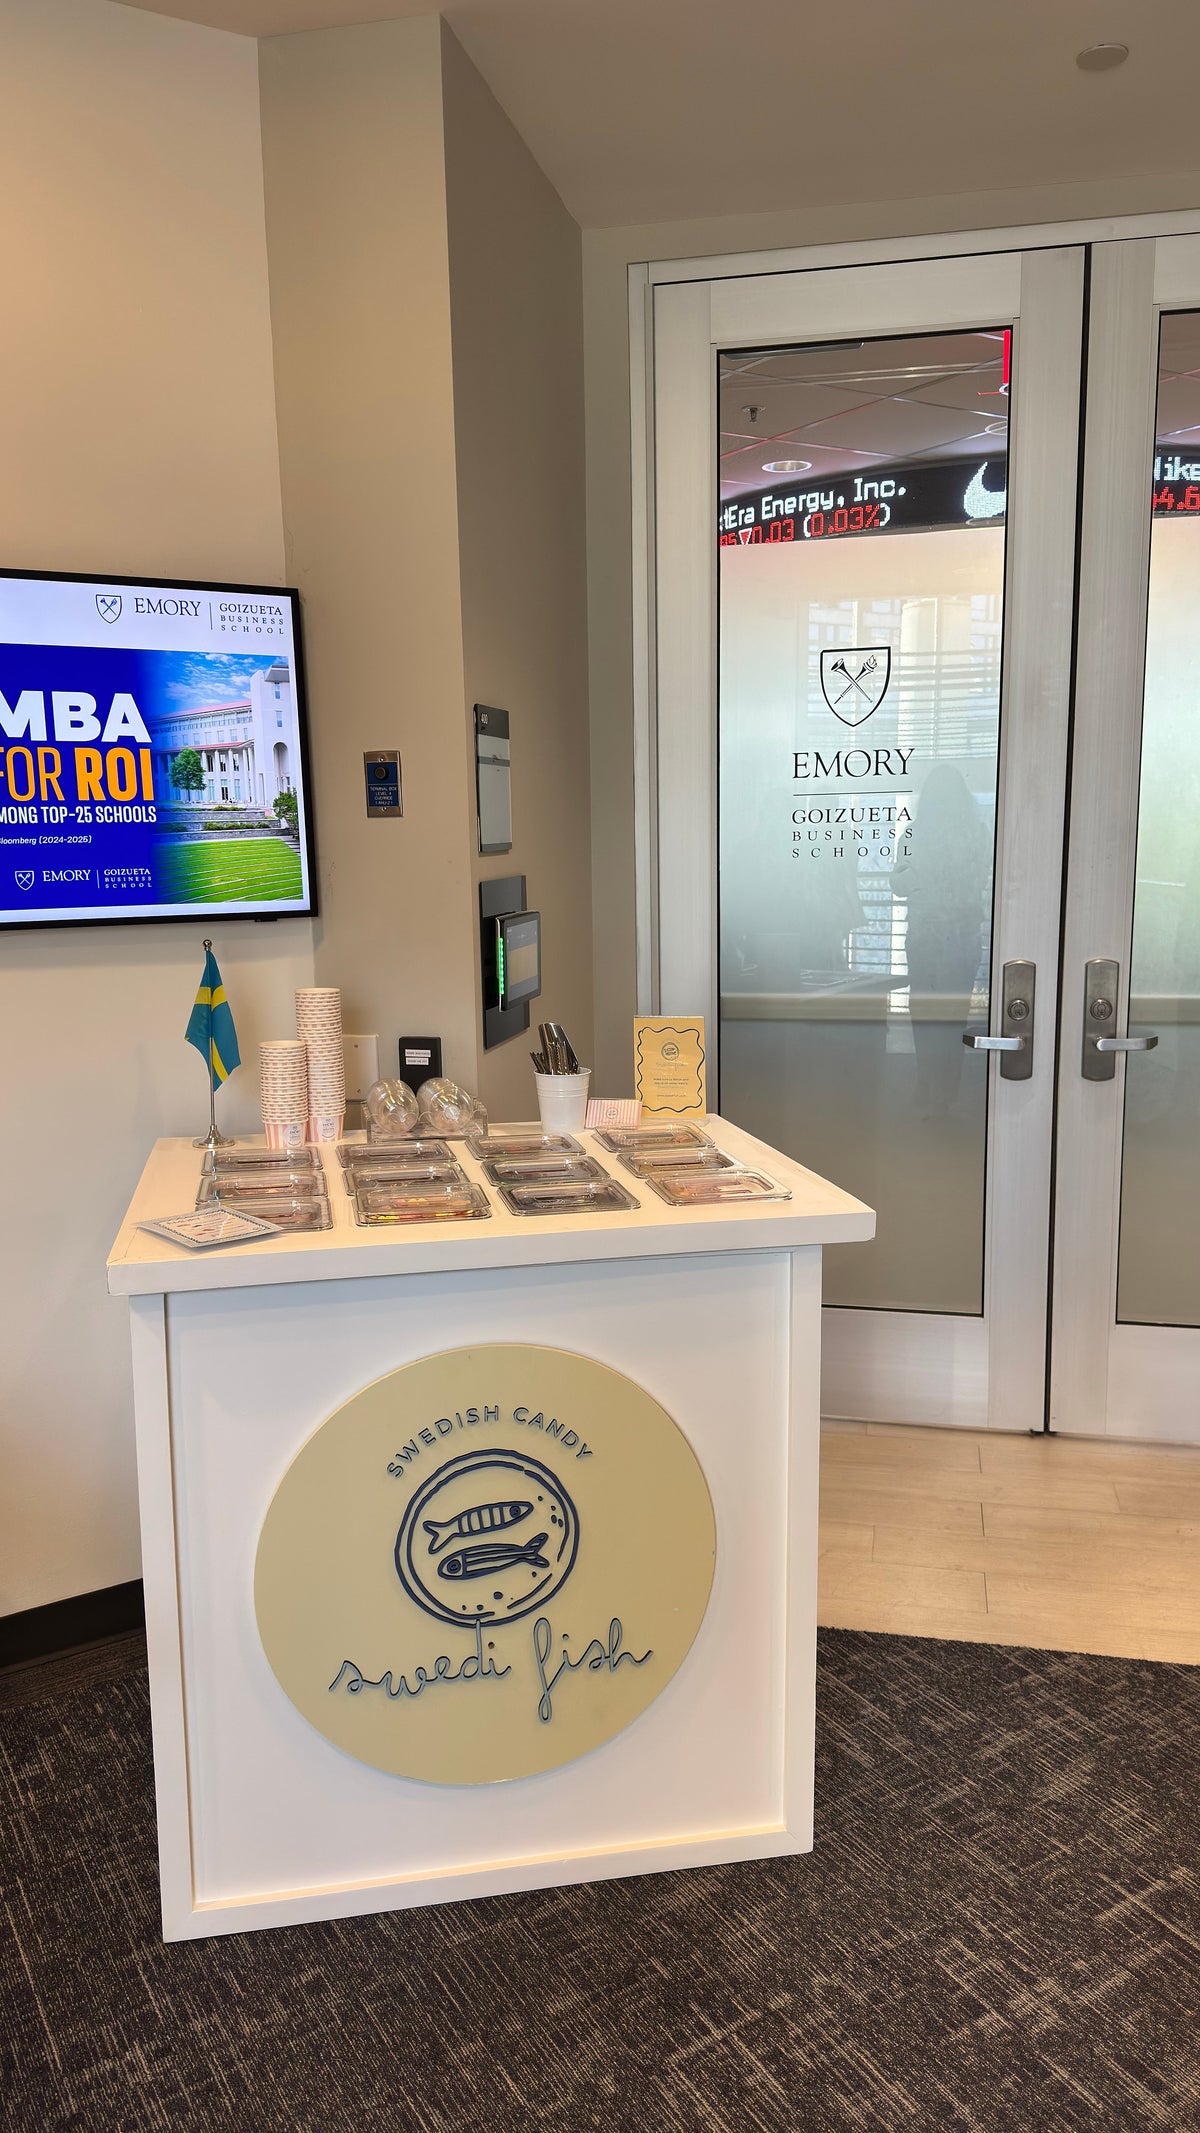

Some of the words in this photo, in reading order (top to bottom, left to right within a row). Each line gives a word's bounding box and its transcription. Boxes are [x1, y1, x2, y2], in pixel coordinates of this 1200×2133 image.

[762, 489, 845, 520] Energy,
[853, 477, 907, 502] Inc.
[1153, 486, 1200, 510] 4.6
[803, 502, 891, 538] (0.03%)
[134, 597, 201, 616] EMORY
[219, 602, 283, 616] GOIZUETA
[220, 615, 284, 625] BUSINESS
[221, 625, 284, 635] SCHOOL
[0, 690, 152, 743] MBA
[792, 748, 915, 779] EMORY
[74, 747, 154, 802] ROI
[41, 806, 93, 824] TOP-25
[95, 805, 157, 823] SCHOOLS
[792, 806, 912, 825] GOIZUETA
[0, 836, 36, 845] loomberg
[39, 835, 92, 845] (2024-2025)
[792, 828, 913, 841] BUSINESS
[792, 846, 912, 858] SCHOOL
[42, 869, 91, 882] EMORY
[103, 868, 151, 876] GOIZUETA
[387, 1405, 499, 1478] SWEDISH
[513, 1406, 593, 1460] CANDY
[329, 1618, 512, 1699] swedi
[533, 1617, 654, 1724] fish
